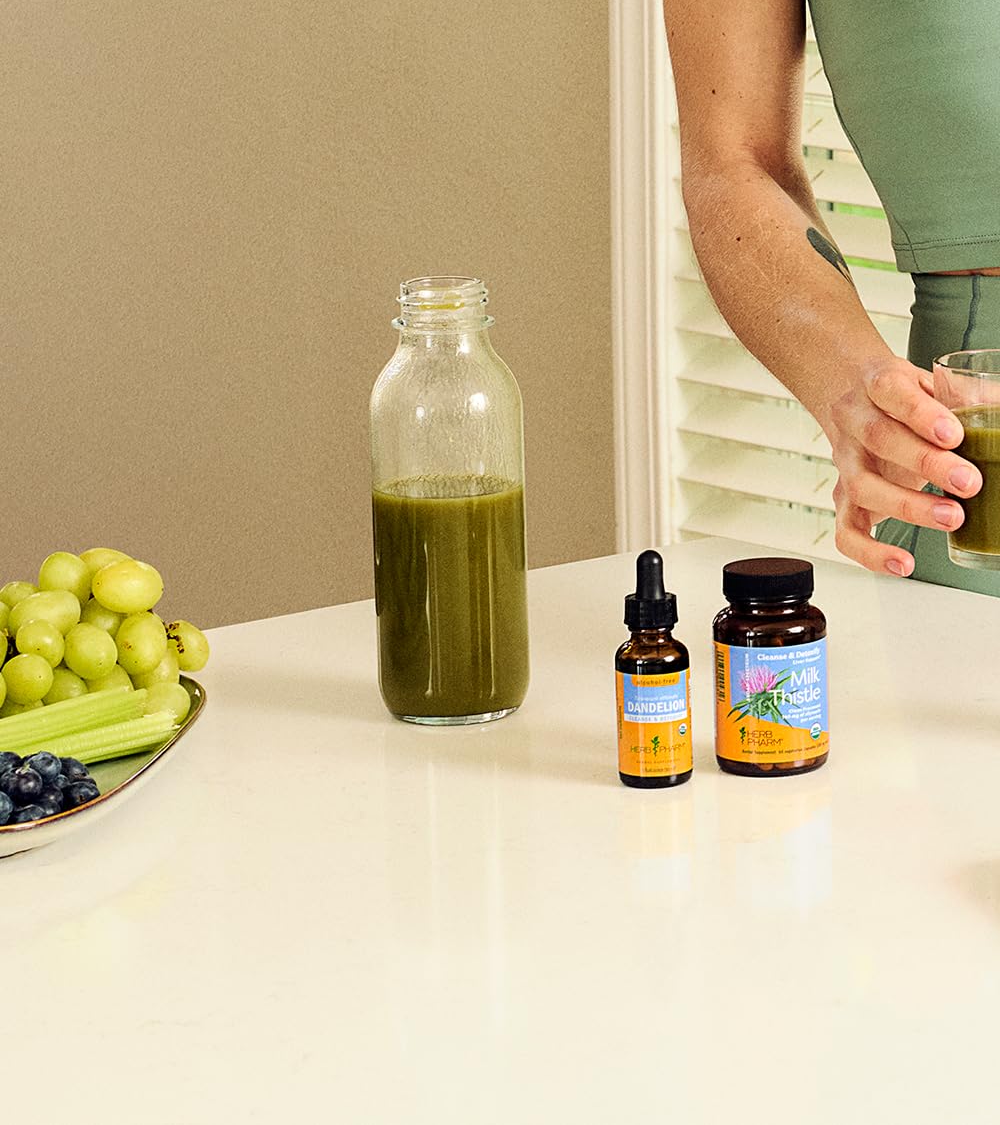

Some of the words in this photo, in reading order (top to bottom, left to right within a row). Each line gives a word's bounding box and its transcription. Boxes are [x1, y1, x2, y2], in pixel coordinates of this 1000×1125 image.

[757, 653, 788, 661] Cleanse
[788, 651, 796, 659] &
[791, 666, 821, 687] Milk
[768, 685, 821, 706] Thistle
[627, 698, 685, 713] DANDELION
[747, 730, 773, 738] HERB
[630, 745, 652, 753] HERB
